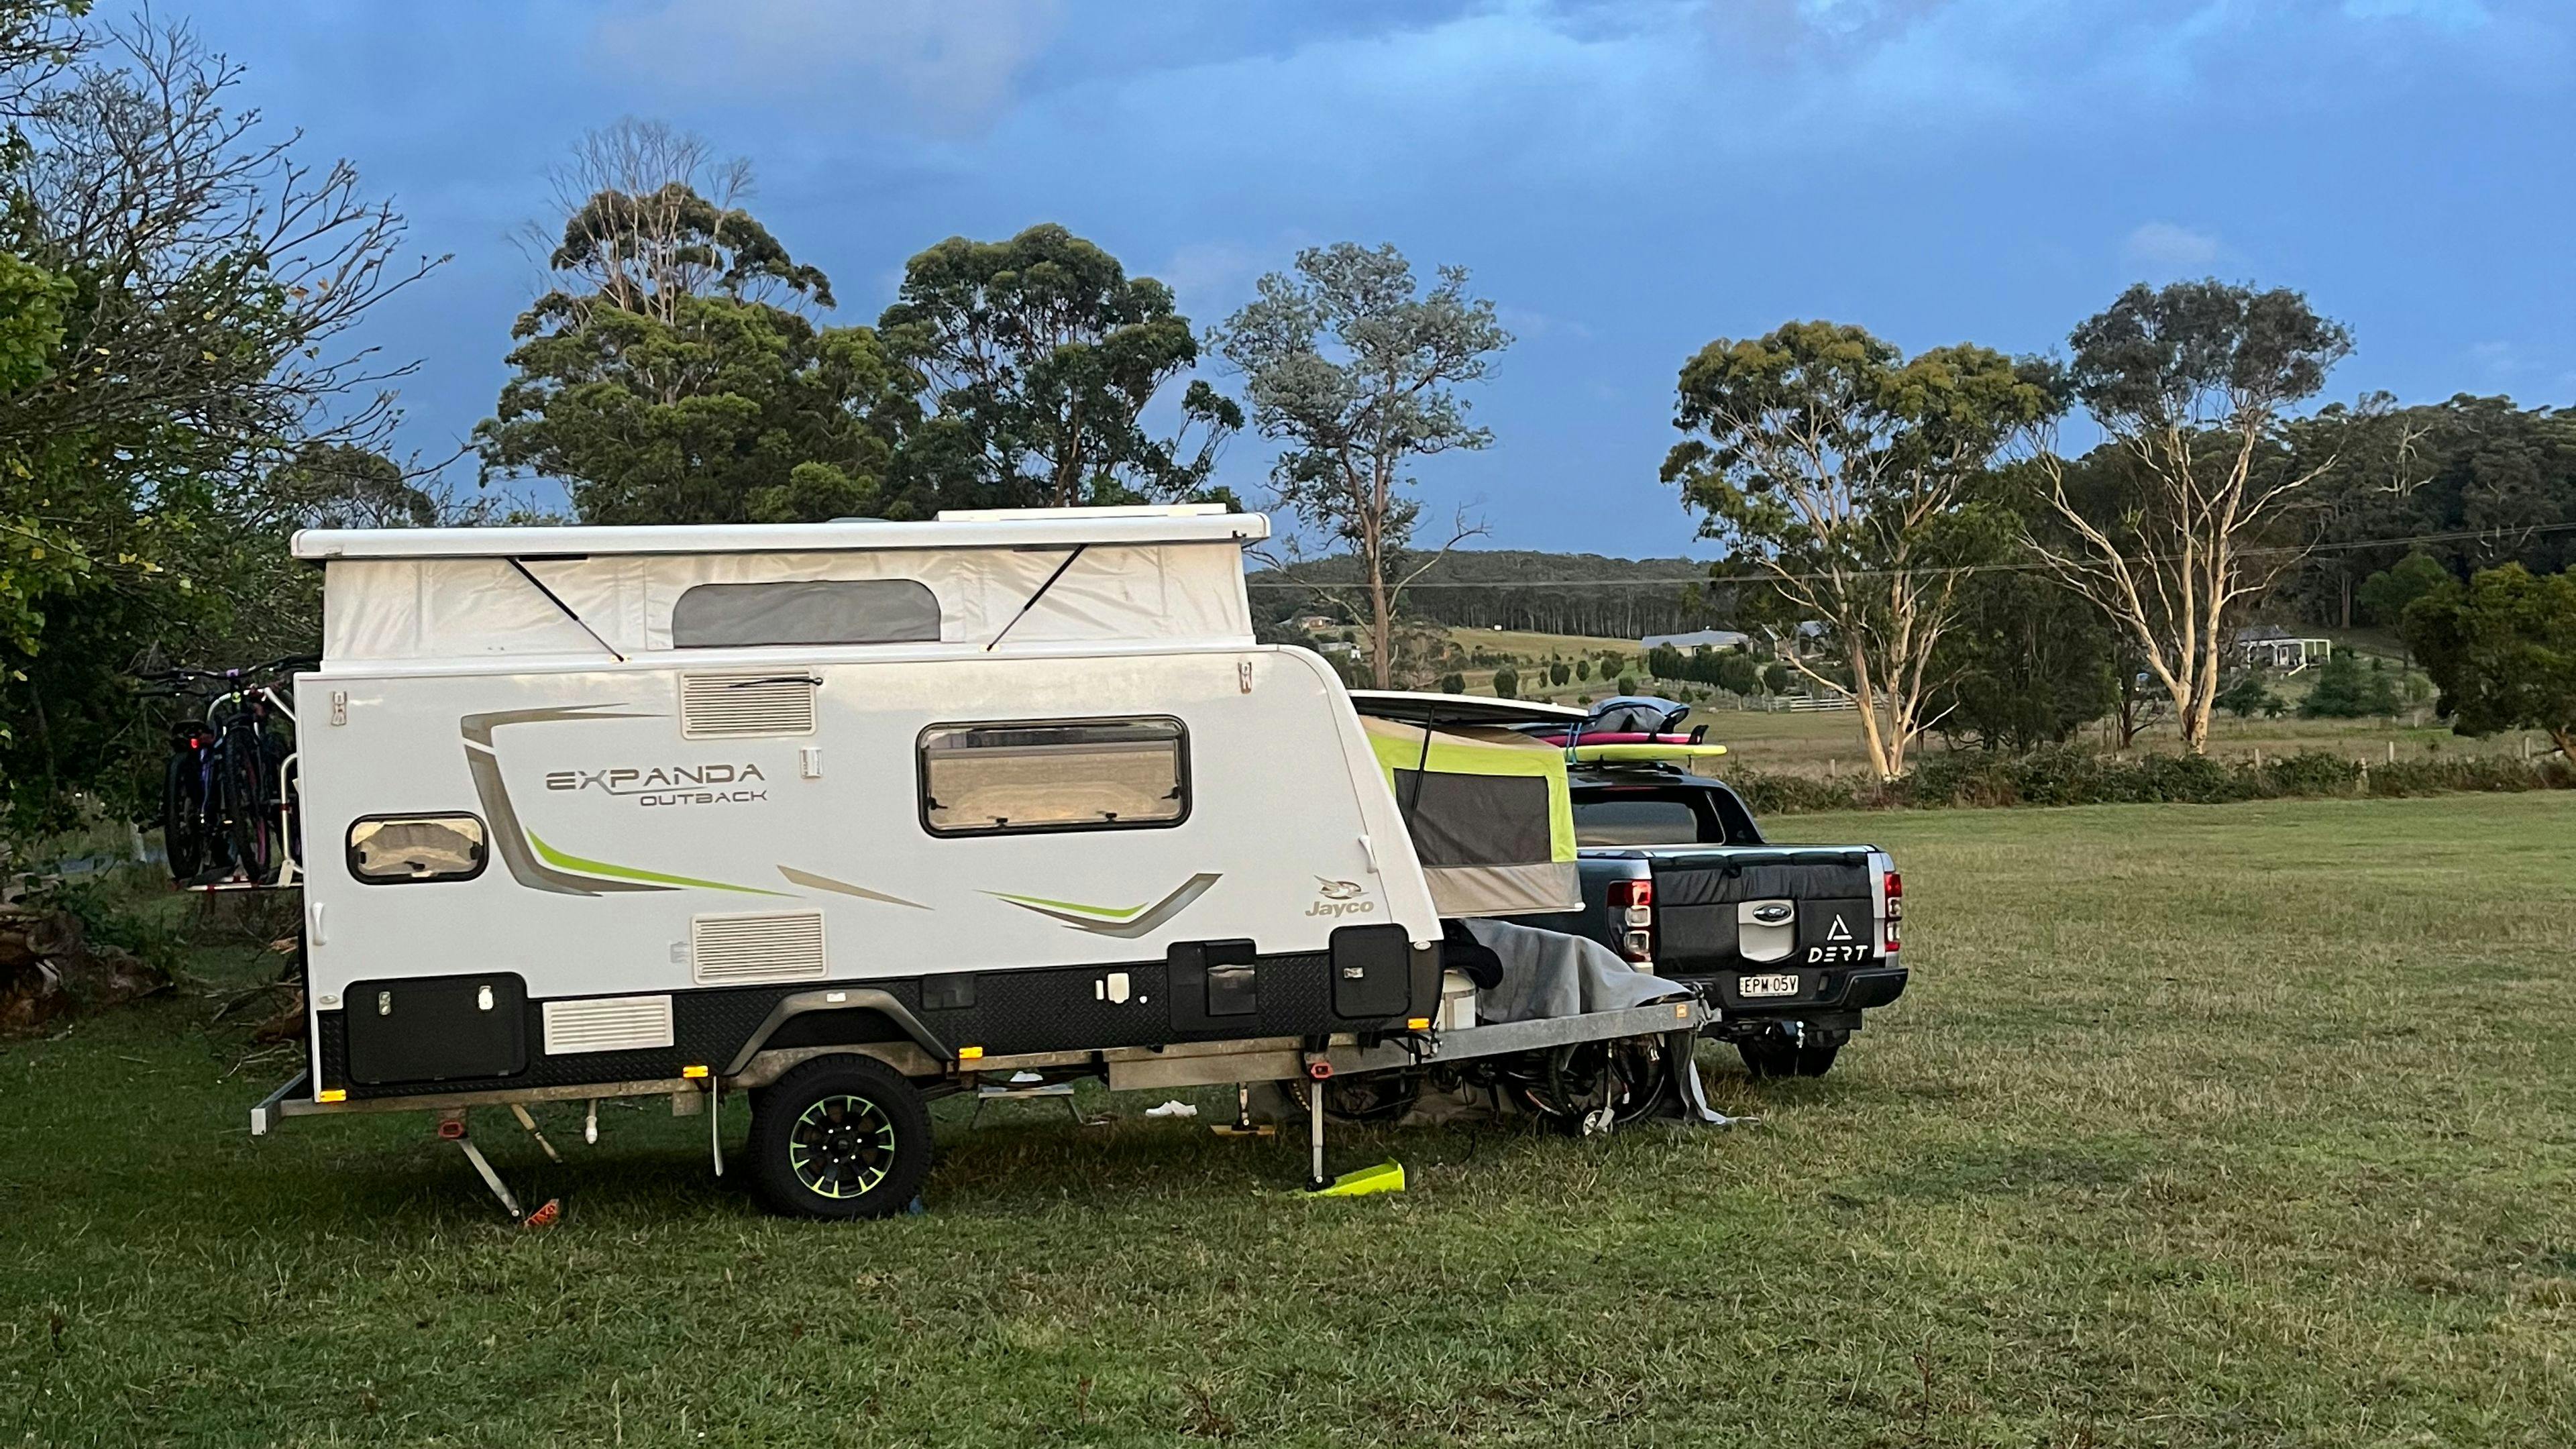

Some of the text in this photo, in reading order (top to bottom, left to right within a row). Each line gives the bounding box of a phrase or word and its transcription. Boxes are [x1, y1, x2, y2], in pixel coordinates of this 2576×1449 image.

[546, 763, 765, 793] EXPANDA
[640, 790, 768, 806] OUTBACK
[1305, 901, 1375, 918] Jayco
[1745, 979, 1769, 993] EPM
